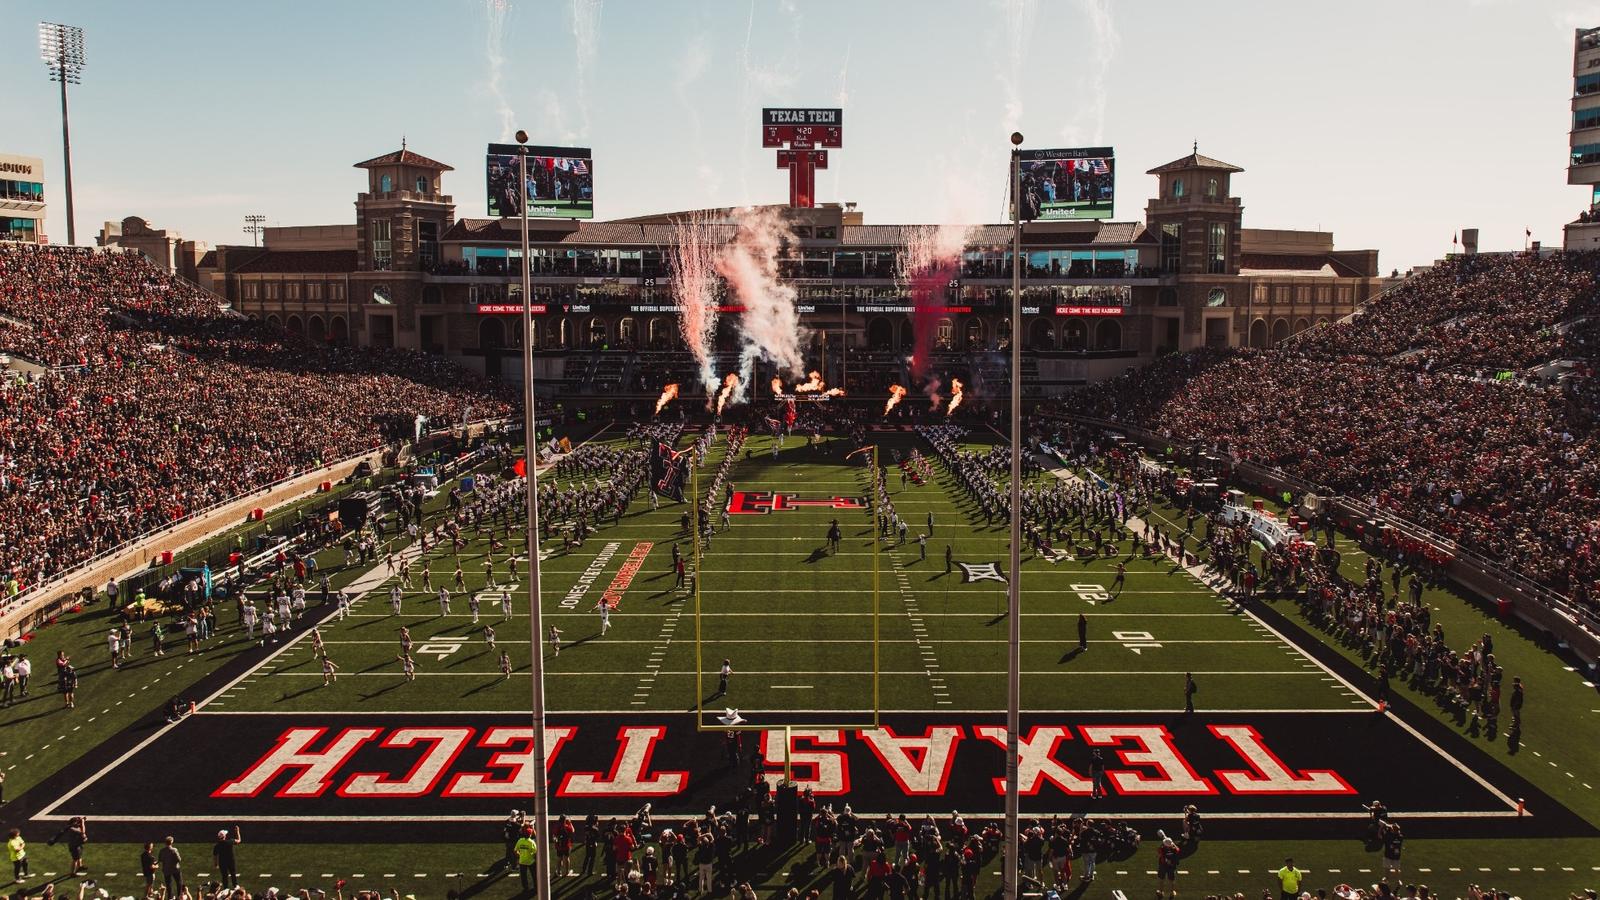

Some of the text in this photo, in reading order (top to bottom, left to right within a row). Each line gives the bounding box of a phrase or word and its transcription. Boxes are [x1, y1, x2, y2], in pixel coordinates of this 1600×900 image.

[769, 110, 835, 122] TEXAS TECH
[1072, 149, 1089, 157] Bank
[527, 205, 557, 213] United
[645, 278, 654, 286] 25
[949, 279, 958, 287] 25
[558, 542, 621, 609] JONES AT&T STADIUM
[417, 636, 469, 654] 10
[1112, 631, 1163, 648] 10
[209, 725, 1358, 798] TEXAS TECH
